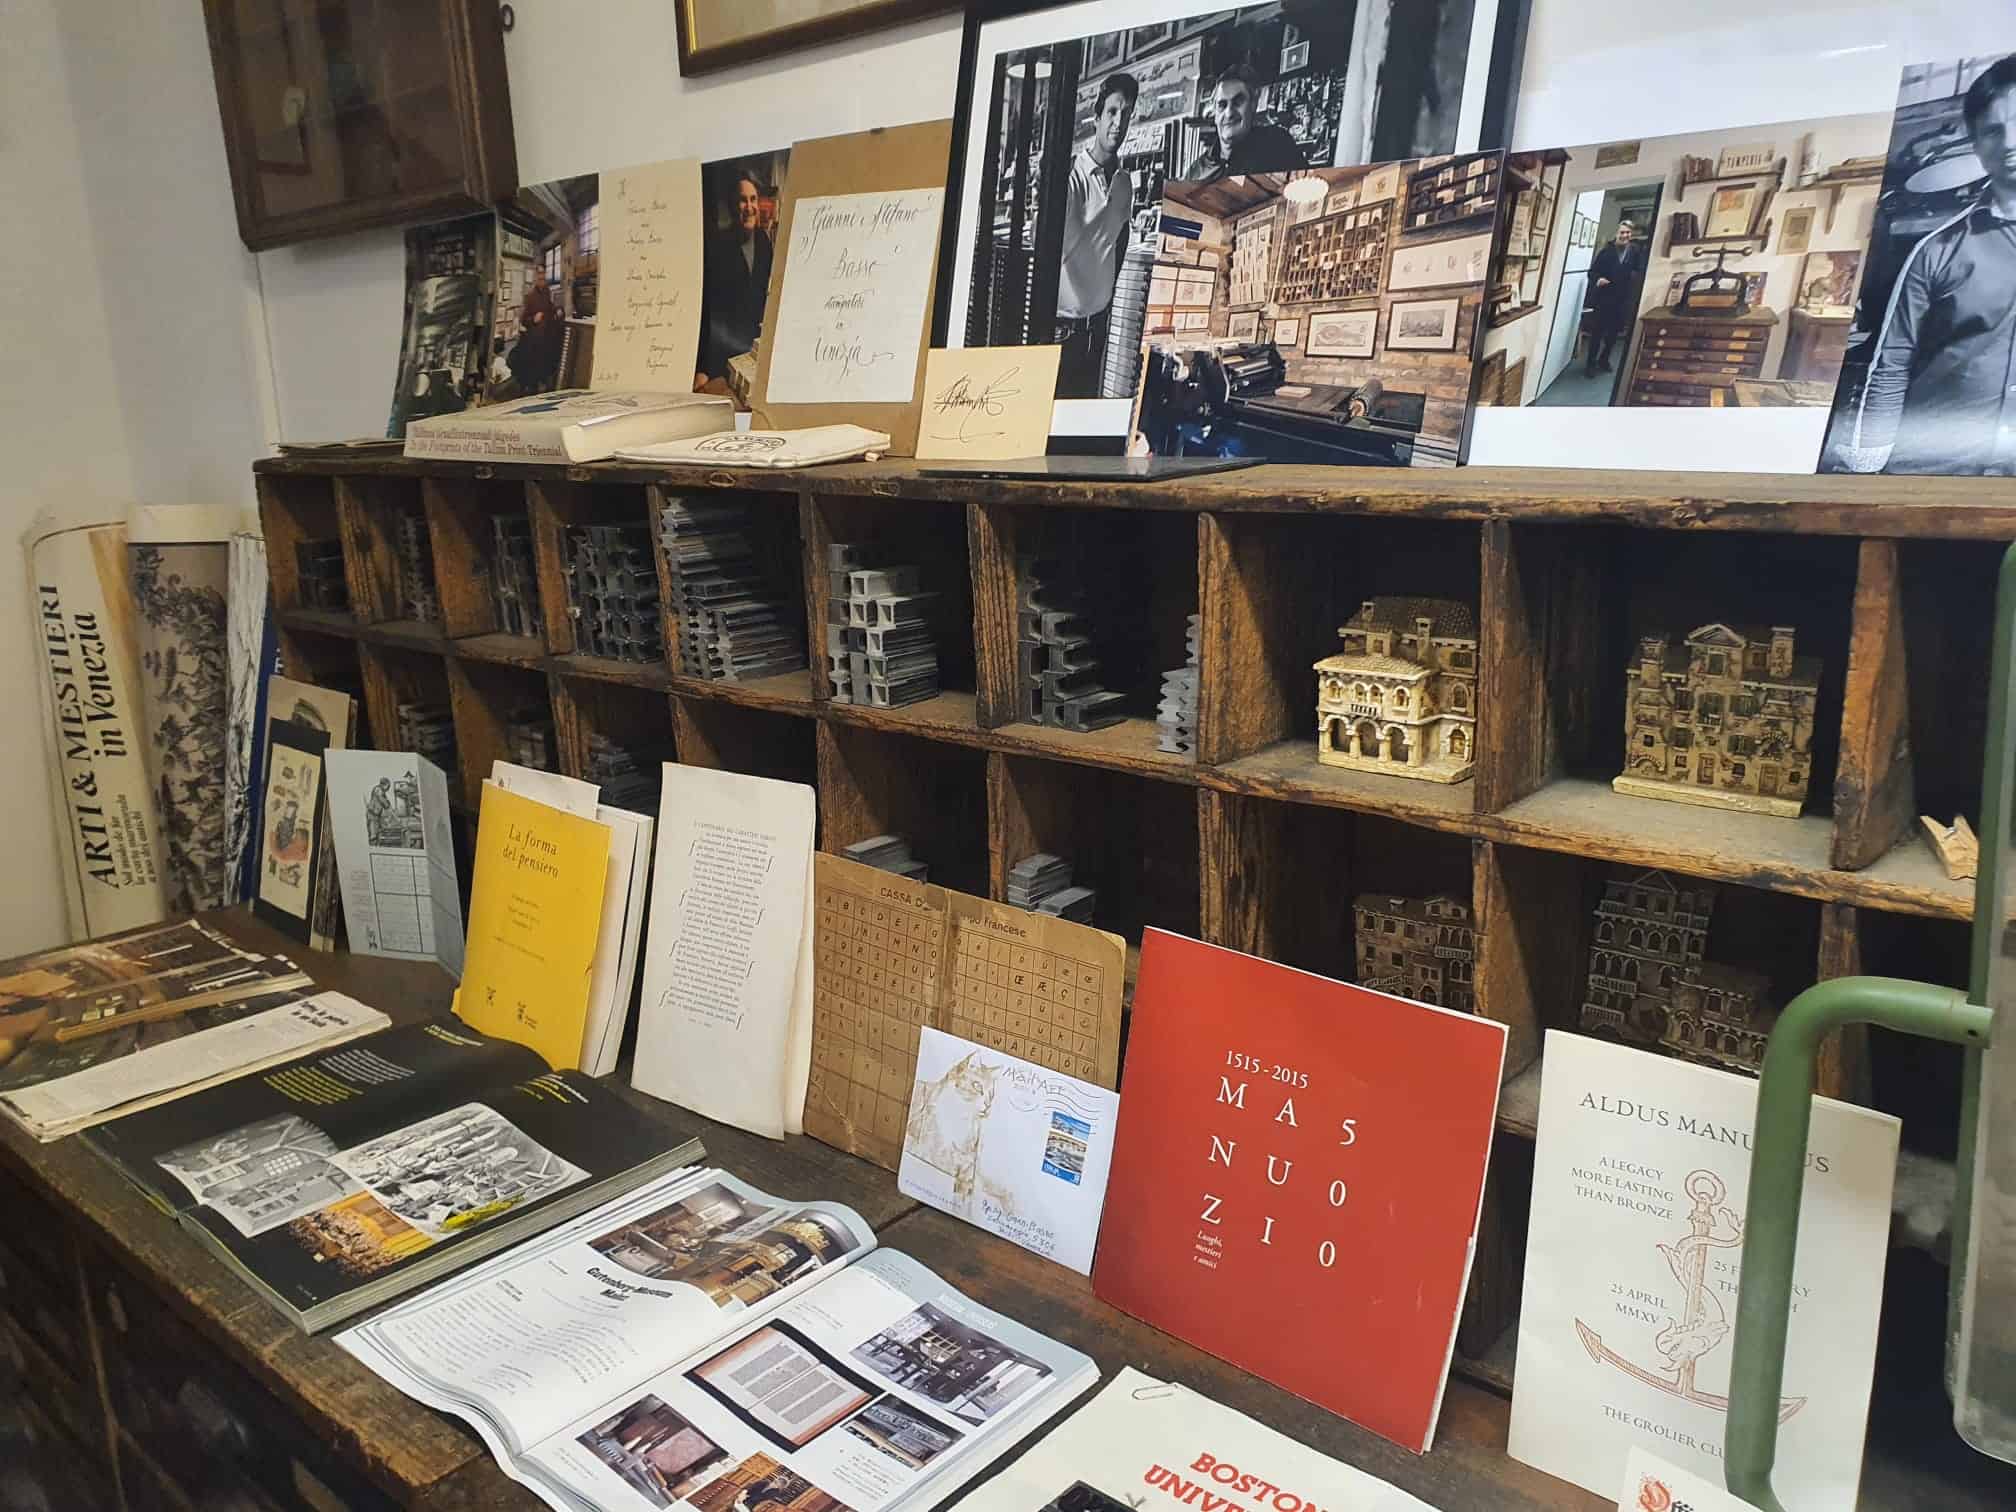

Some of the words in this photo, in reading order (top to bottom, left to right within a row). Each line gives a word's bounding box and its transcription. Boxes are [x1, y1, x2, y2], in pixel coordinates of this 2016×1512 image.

[39, 585, 92, 762] MESTIERI
[69, 612, 119, 724] Venezia
[93, 728, 128, 758] in
[71, 770, 98, 797] &
[75, 804, 120, 890] ARTI
[508, 823, 521, 843] La
[524, 830, 557, 856] forma
[502, 846, 516, 862] del
[517, 852, 559, 879] pensiero
[880, 887, 912, 905] CASSA
[1216, 1076, 1249, 1110] M
[1274, 1098, 1299, 1128] A
[1339, 1119, 1357, 1146] 5
[1578, 1092, 1670, 1127] ALDUS
[1207, 1135, 1237, 1168] N
[1266, 1154, 1293, 1185] U
[1328, 1180, 1347, 1207] 0
[1571, 1166, 1613, 1186] MORE
[1615, 1177, 1674, 1202] LASTING
[1599, 1156, 1609, 1168] A
[1611, 1159, 1665, 1181] LEGACY
[1574, 1184, 1615, 1205] THAN
[1616, 1196, 1674, 1221] BRONZE
[1200, 1193, 1224, 1225] Z
[1260, 1215, 1276, 1245] I
[1318, 1240, 1336, 1268] 0
[1713, 1260, 1728, 1273] 25
[1609, 1283, 1626, 1295] 25
[1626, 1287, 1668, 1310] APRIL
[1614, 1302, 1661, 1325] MMXV
[1602, 1405, 1633, 1424] THE
[1633, 1418, 1697, 1449] GROLIER
[1700, 1442, 1725, 1459] CLU
[1143, 1464, 1252, 1512] UNIVE
